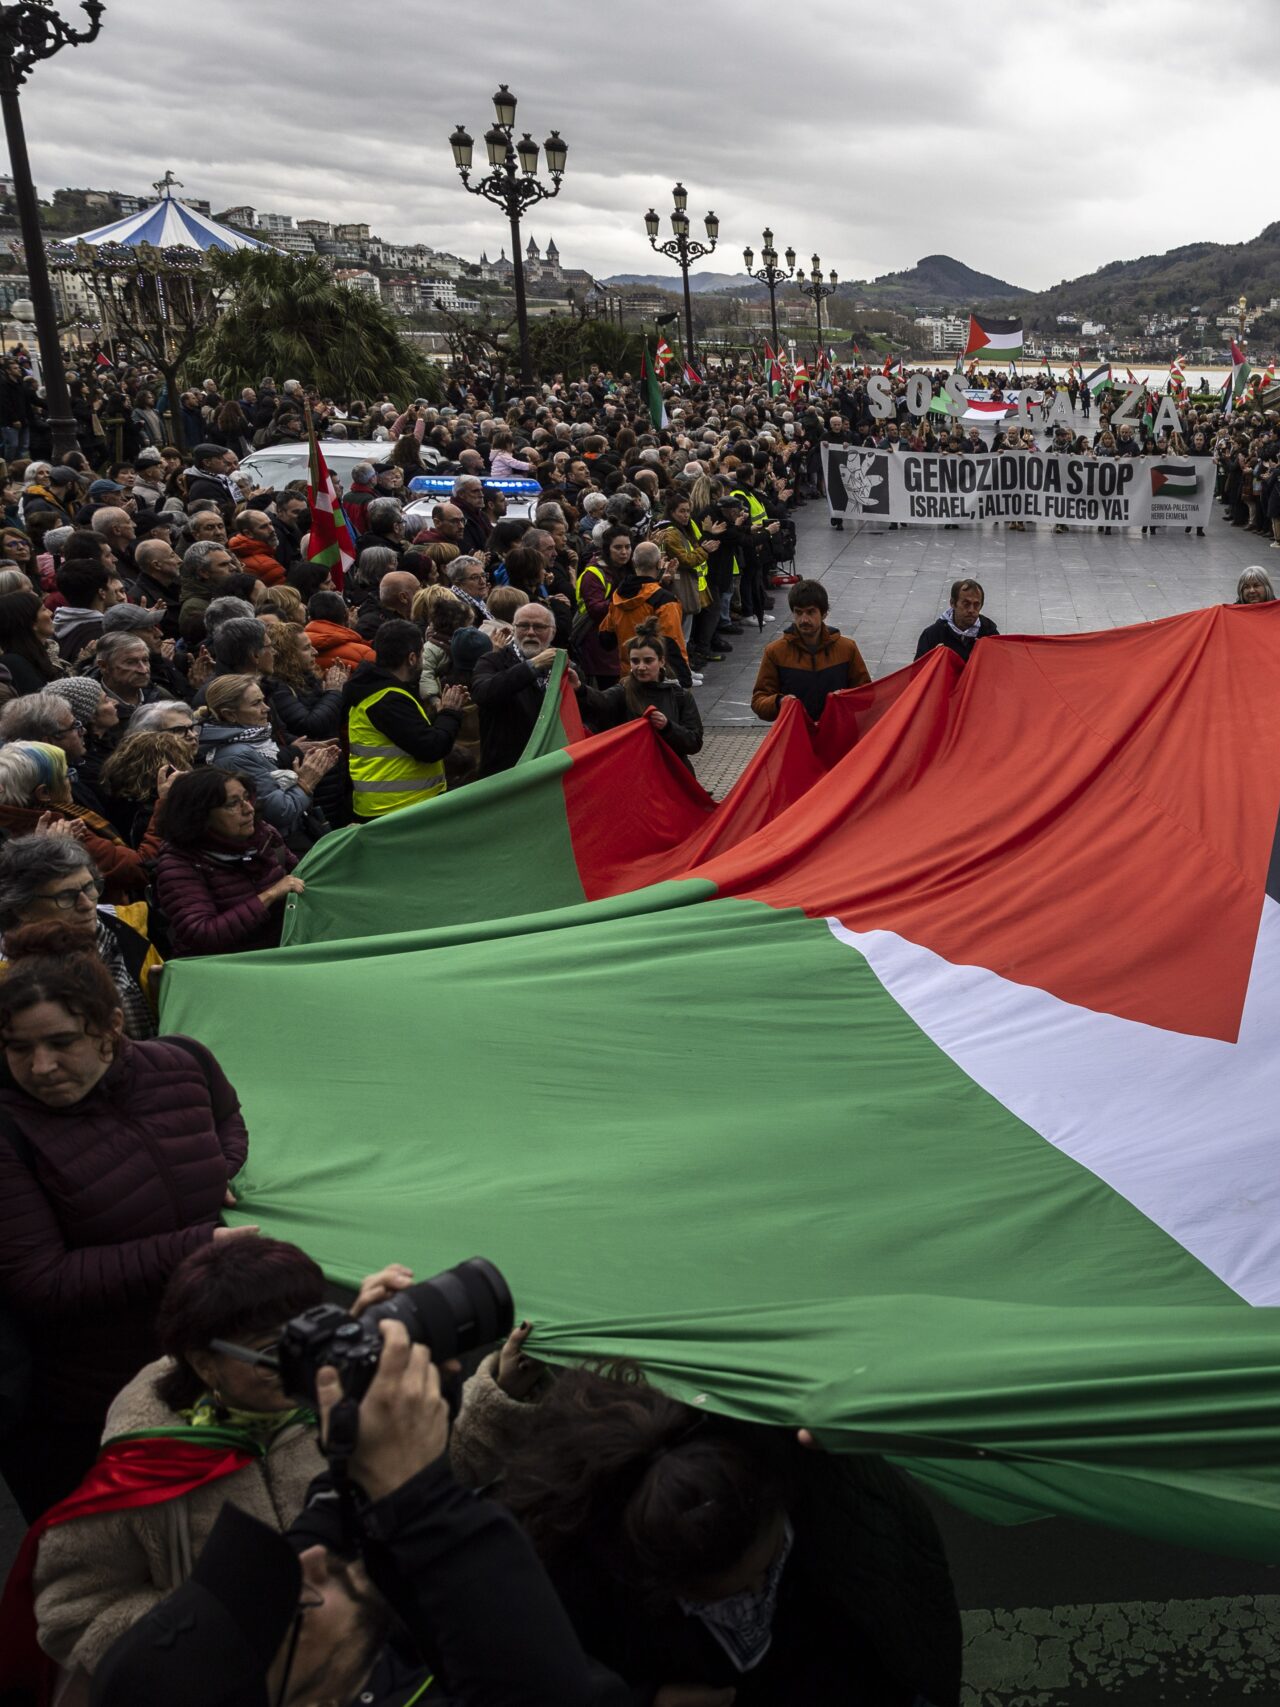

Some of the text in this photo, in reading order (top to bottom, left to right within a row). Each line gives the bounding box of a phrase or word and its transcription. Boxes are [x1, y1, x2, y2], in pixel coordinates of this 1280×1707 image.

[867, 373, 1183, 433] SOS GAZA
[904, 455, 1134, 497] GENOZIDIOA STOP
[909, 493, 1129, 520] ISRAEL, ¡ALTO EL FUEGO YA!
[1150, 503, 1200, 512] GERNIKA-PALESTINA
[1150, 512, 1188, 520] HERRI EKIMENA
